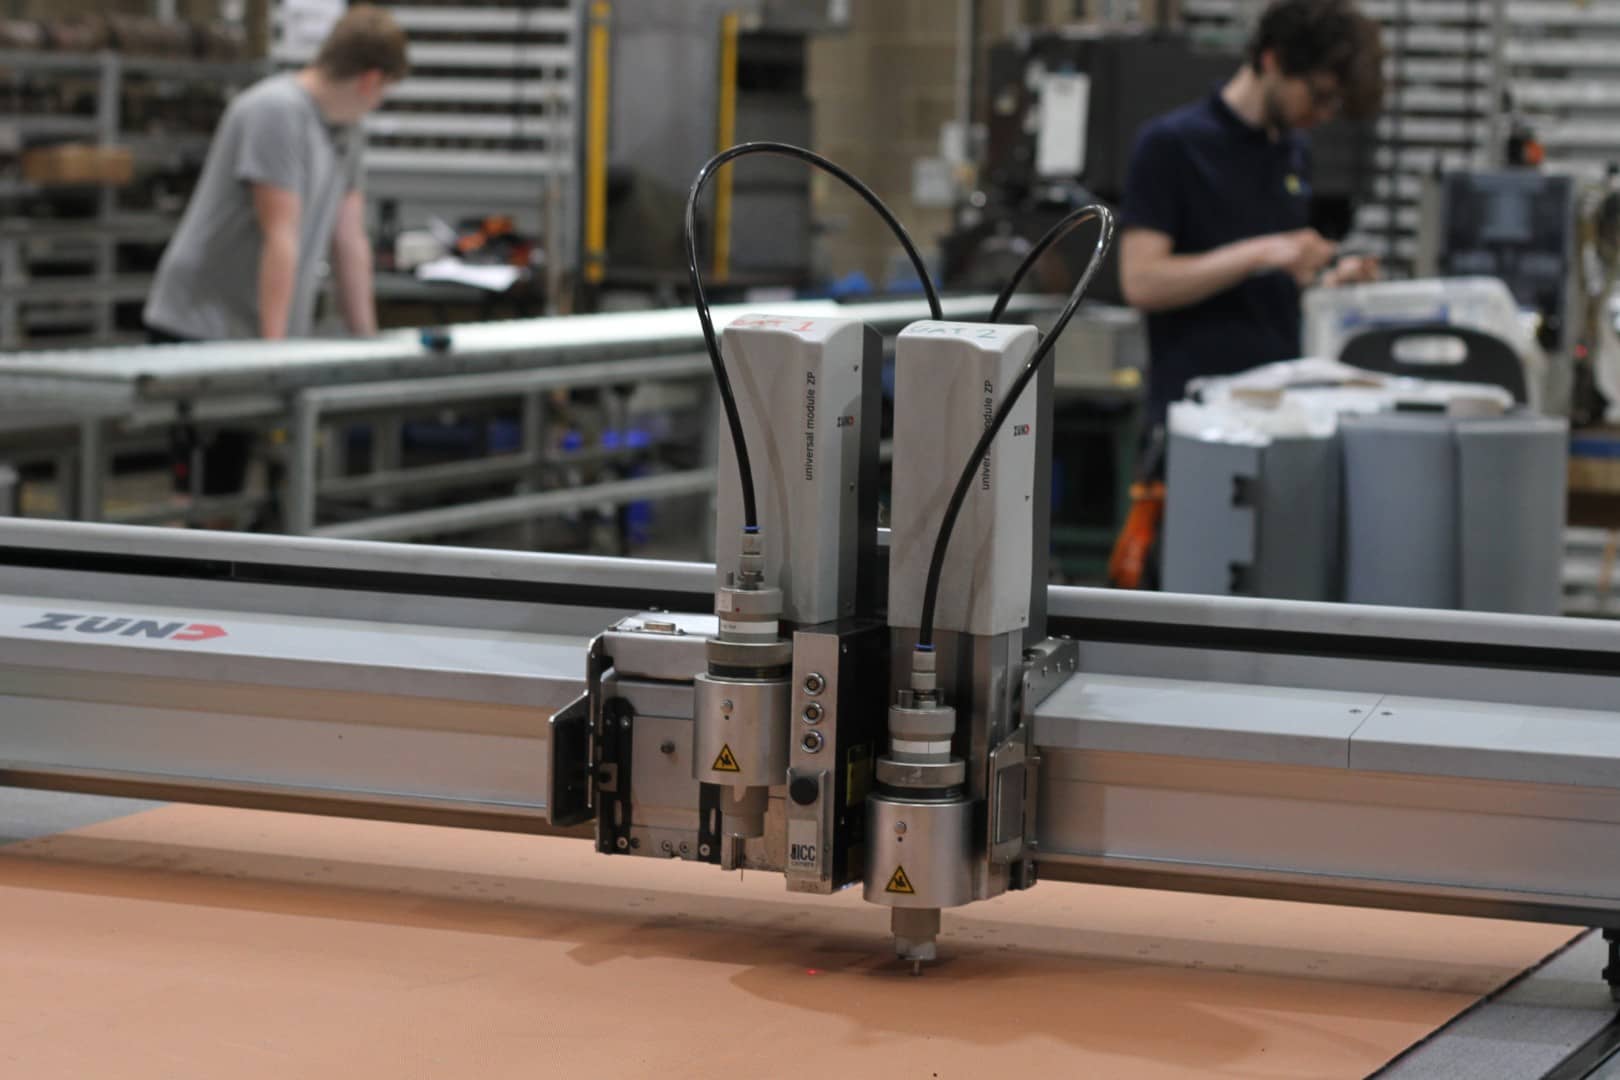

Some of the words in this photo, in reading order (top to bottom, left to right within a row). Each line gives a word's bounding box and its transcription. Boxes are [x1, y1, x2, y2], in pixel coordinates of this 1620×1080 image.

[976, 328, 1000, 340] 2
[806, 371, 816, 386] ZP
[984, 379, 993, 394] ZP
[806, 388, 816, 430] module
[804, 431, 815, 481] universal
